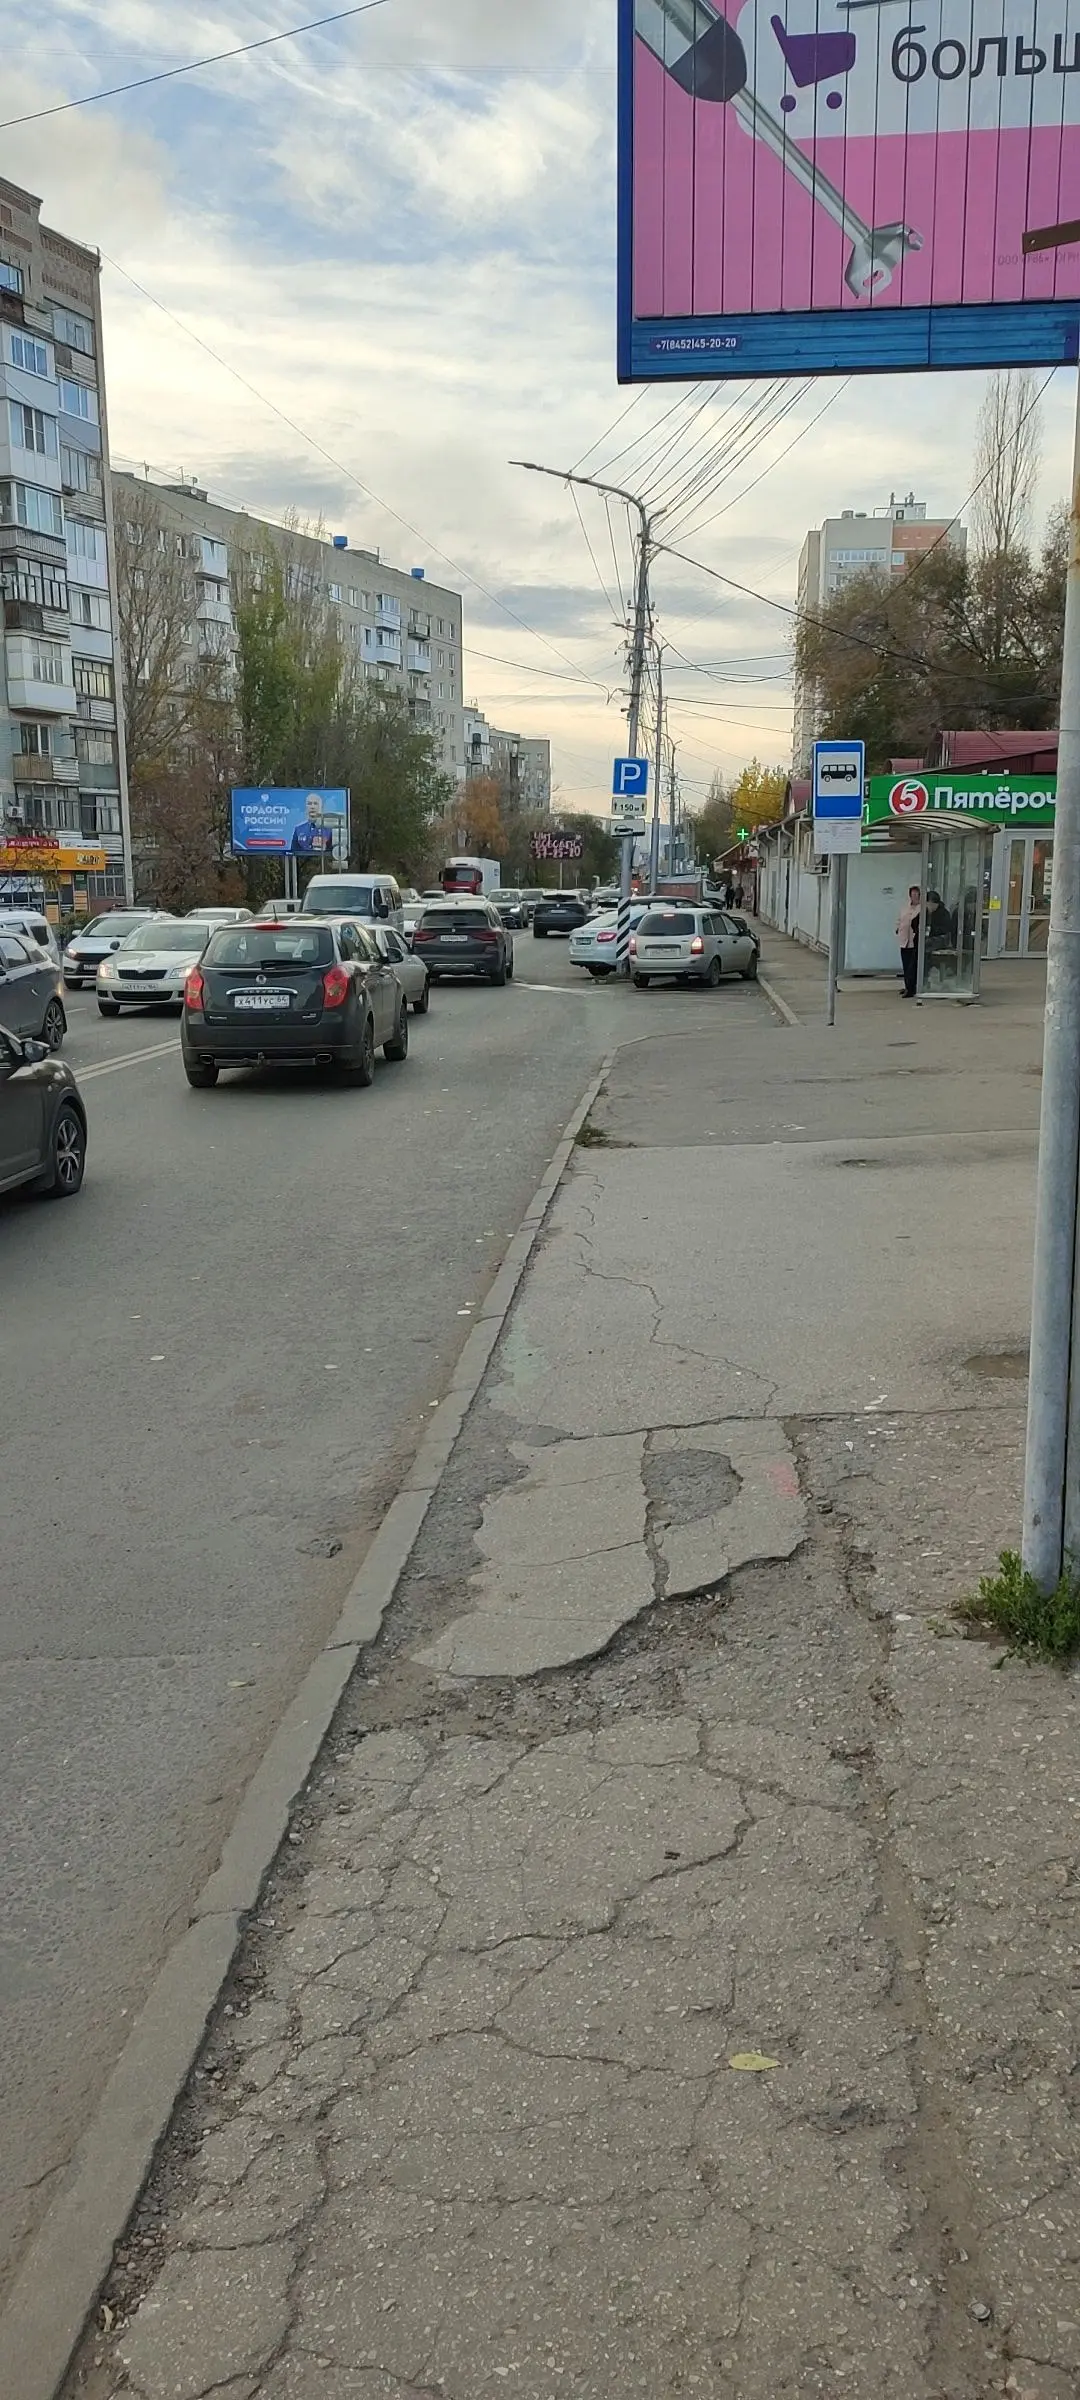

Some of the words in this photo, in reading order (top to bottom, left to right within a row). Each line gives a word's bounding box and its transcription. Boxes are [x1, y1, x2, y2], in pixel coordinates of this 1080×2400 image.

[655, 338, 736, 350] +7(8452)45-20-20
[240, 805, 291, 815] ГОРДОСТЬ
[244, 816, 287, 825] РОССИИ!
